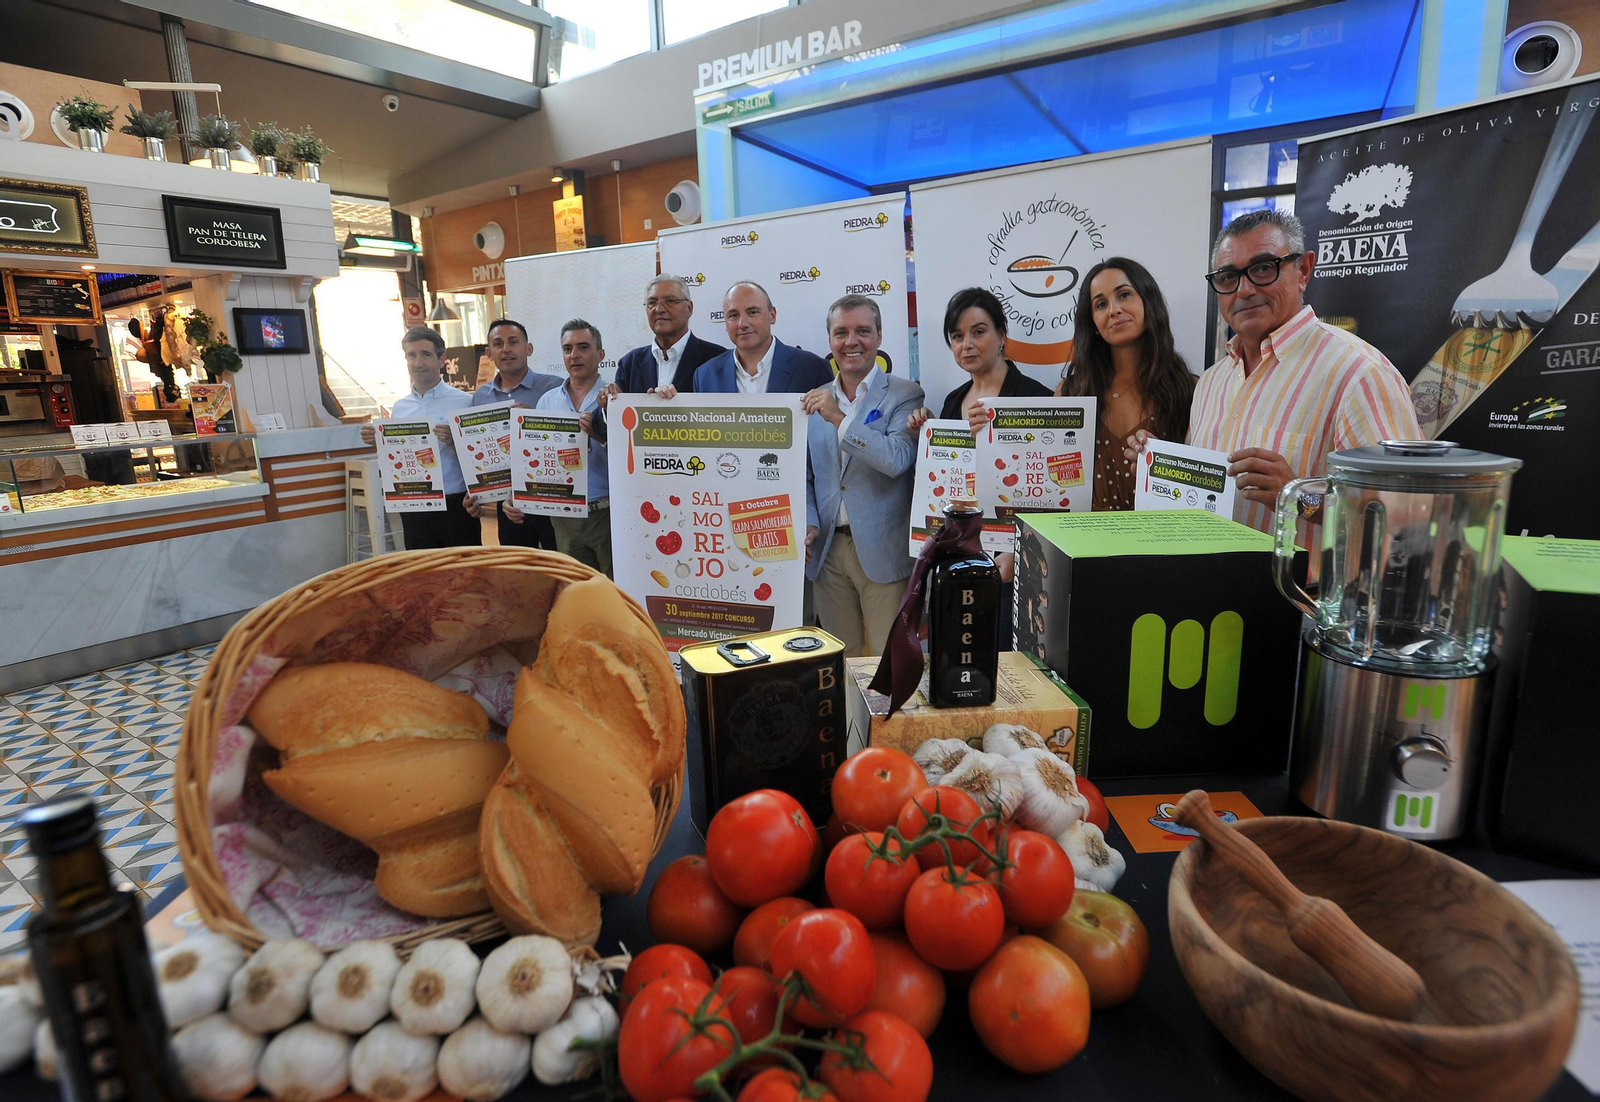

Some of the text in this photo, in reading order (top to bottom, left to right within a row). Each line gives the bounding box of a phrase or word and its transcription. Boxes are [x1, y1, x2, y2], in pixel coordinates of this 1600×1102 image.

[698, 20, 862, 88] PREMIUM BAR
[738, 96, 771, 112] SALIDA
[1318, 141, 1386, 162] ACEITE
[1402, 132, 1424, 145] DE
[1442, 116, 1513, 137] OLIVA
[213, 221, 242, 230] MASA
[1027, 192, 1106, 251] gastronómica
[1318, 222, 1372, 236] Denominación
[1386, 218, 1413, 229] Origen
[188, 227, 210, 236] PAN
[230, 231, 267, 241] TELERA
[196, 237, 261, 249] CORDOBESA
[1316, 233, 1408, 265] BAENA
[1314, 262, 1408, 279] Consejo Regulador
[642, 412, 786, 423] Concurso Nacional Amateur
[1490, 412, 1518, 422] Europa
[643, 428, 786, 442] SALMOREJO cordobés
[1026, 462, 1044, 470] MO
[1155, 456, 1224, 476] Concurso Nacional Amateur
[1026, 473, 1044, 484] RE
[1154, 466, 1222, 489] SALMOREJO cordobés
[692, 492, 724, 506] SAL
[950, 487, 963, 496] RE
[1025, 487, 1043, 497] JO
[746, 499, 778, 509] Octubre
[692, 512, 723, 527] MO
[733, 515, 792, 533] GRAN SALMOREJADA
[694, 533, 724, 554] RE
[752, 532, 779, 548] GRATIS
[695, 557, 724, 578] JO
[675, 584, 746, 602] cordobés
[666, 604, 677, 616] 30
[679, 610, 710, 619] septiembre
[725, 614, 755, 623] CONCURSO
[678, 628, 708, 638] Mercado
[960, 589, 975, 683] Baena
